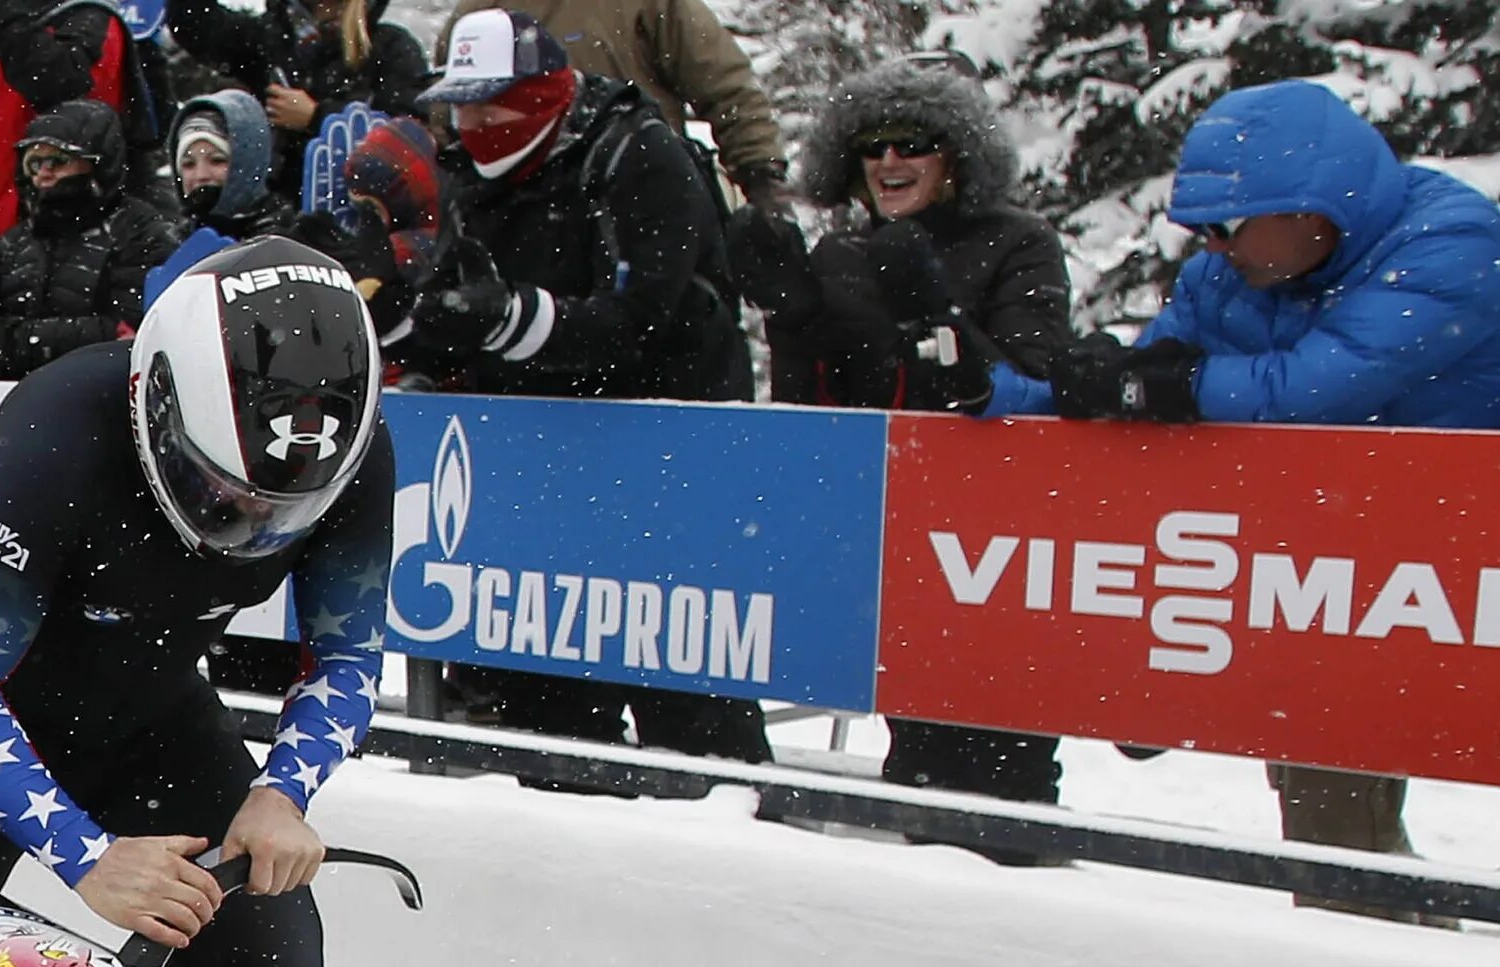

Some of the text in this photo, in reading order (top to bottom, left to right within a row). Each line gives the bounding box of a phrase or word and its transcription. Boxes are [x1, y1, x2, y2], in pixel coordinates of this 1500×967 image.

[0, 541, 30, 572] 21
[928, 510, 1500, 675] VIESSMA
[474, 565, 774, 685] GAZPROM
